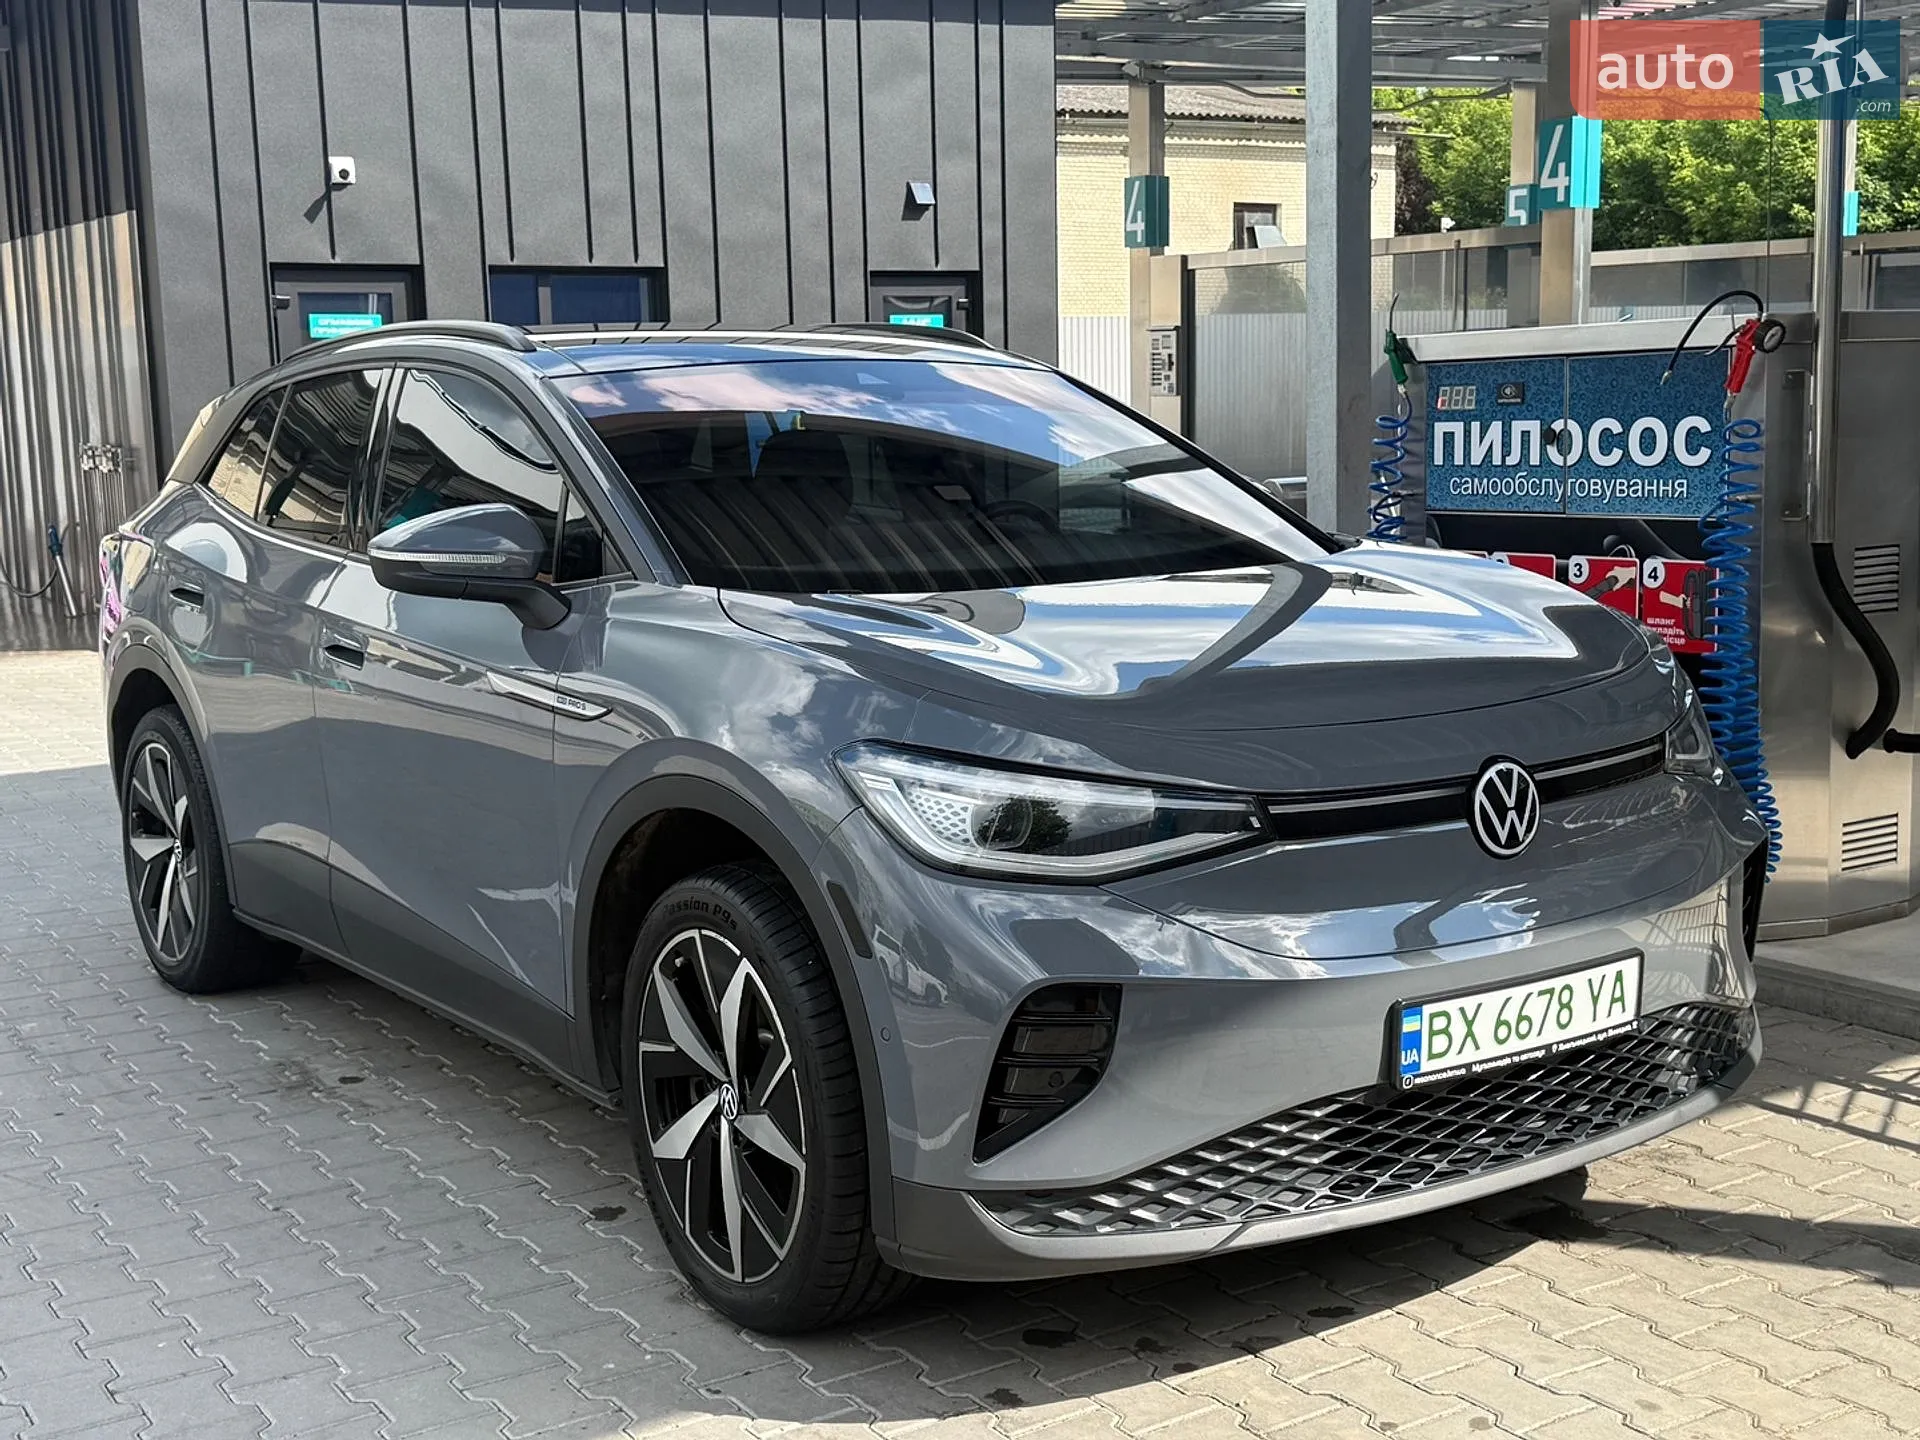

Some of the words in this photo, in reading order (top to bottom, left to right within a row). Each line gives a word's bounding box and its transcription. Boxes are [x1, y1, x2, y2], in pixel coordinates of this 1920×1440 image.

[1540, 124, 1570, 203] 4
[1125, 180, 1145, 243] 4
[1508, 188, 1528, 226] 5
[1432, 415, 1712, 467] ПИЛОСОС
[1450, 471, 1688, 504] самообслуговування
[1573, 562, 1583, 578] 3
[1647, 566, 1659, 582] 4
[1427, 1002, 1483, 1062] BX
[1493, 983, 1574, 1046] 6678
[1587, 969, 1626, 1023] YA
[1401, 1050, 1419, 1066] UA
